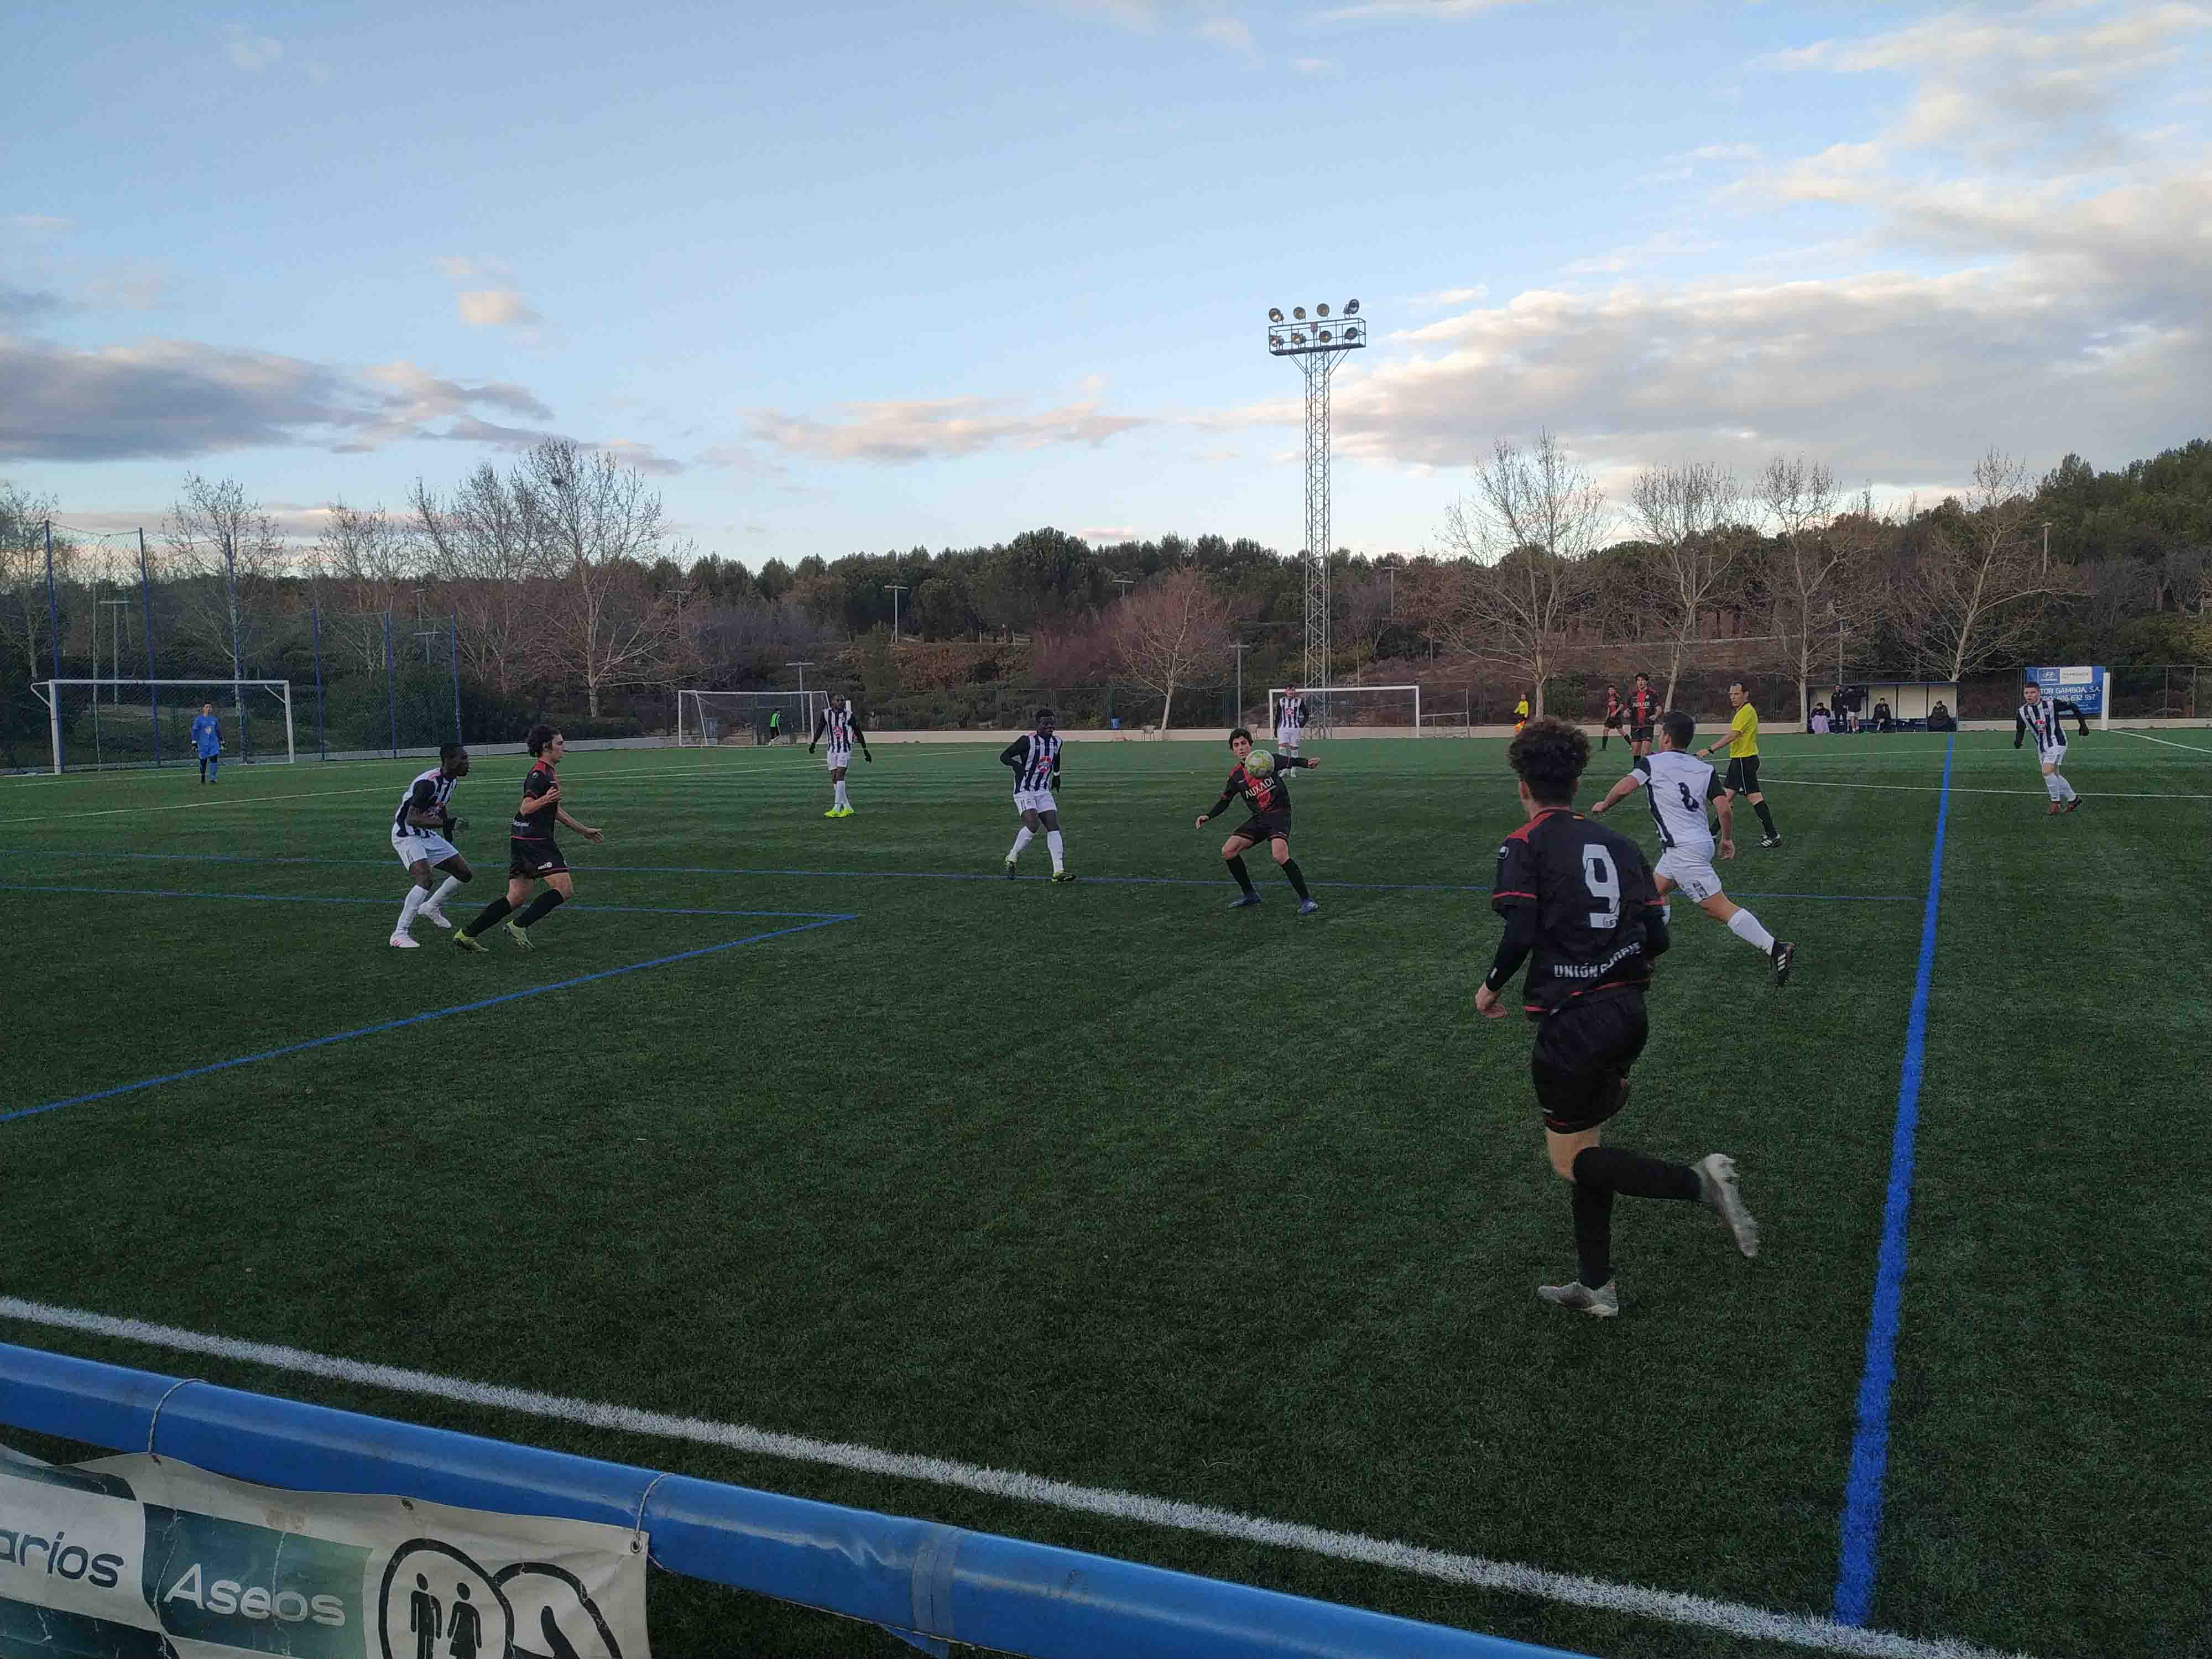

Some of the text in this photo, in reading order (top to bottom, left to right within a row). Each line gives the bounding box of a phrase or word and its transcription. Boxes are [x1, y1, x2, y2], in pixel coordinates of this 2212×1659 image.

[1245, 776, 1275, 799] AUXADI
[1678, 781, 1699, 812] 8
[1582, 843, 1621, 928] 9
[163, 1563, 346, 1627] Aseos
